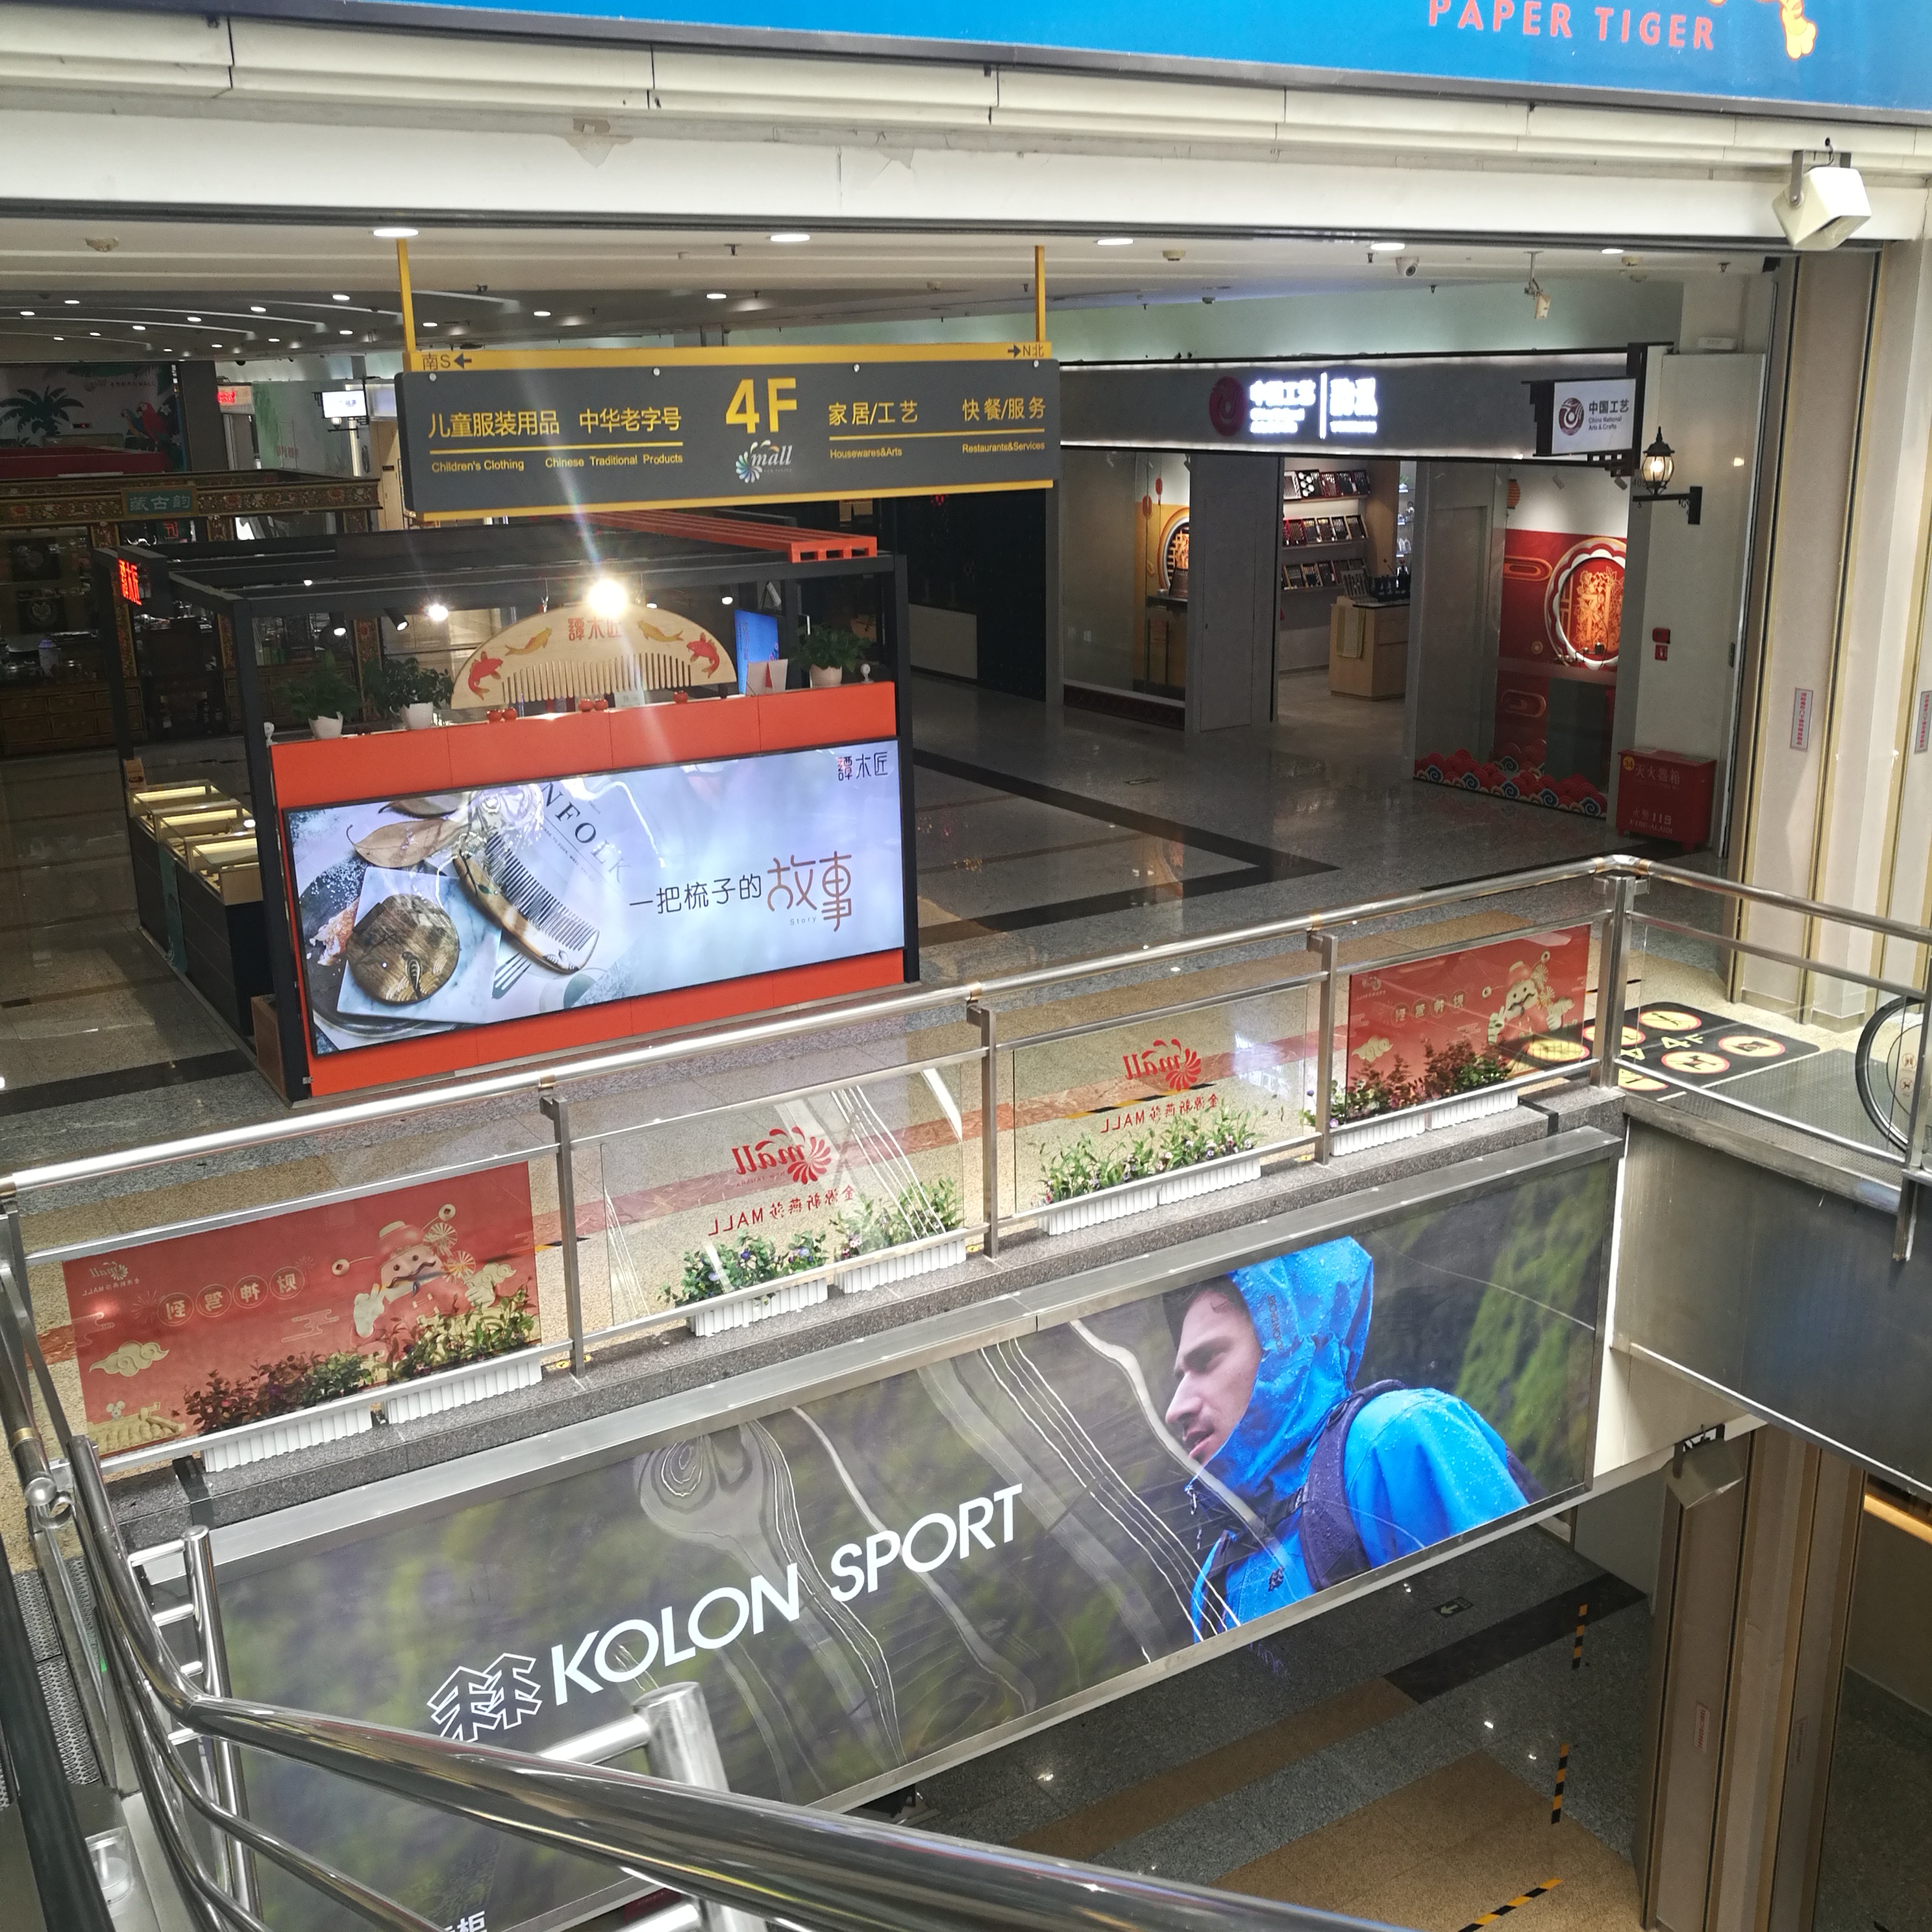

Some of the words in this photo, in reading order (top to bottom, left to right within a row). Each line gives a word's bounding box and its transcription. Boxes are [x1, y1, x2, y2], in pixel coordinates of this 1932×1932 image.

[1428, 0, 1572, 38] PAPER
[1594, 6, 1715, 50] TIGER
[725, 377, 798, 434] 4F
[829, 401, 919, 426] 家居/工艺
[962, 397, 1046, 422] 快餐/服务
[1589, 399, 1629, 414] 中国工艺
[428, 410, 560, 440] 儿童服装用品
[579, 407, 682, 434] 中华老字号
[751, 445, 793, 466] mall
[830, 447, 902, 460] Housewares&Arts
[962, 441, 1045, 453] Restaurants&Services
[431, 460, 481, 473] Children's
[484, 458, 525, 472] Clothing
[545, 457, 584, 468] Chinese
[589, 455, 638, 466] Traditional
[643, 454, 683, 465] Products
[1635, 764, 1680, 785] 灭火器箱
[790, 916, 817, 926] Story
[551, 1564, 800, 1705] KOLON
[831, 1483, 1023, 1602] SPORT
